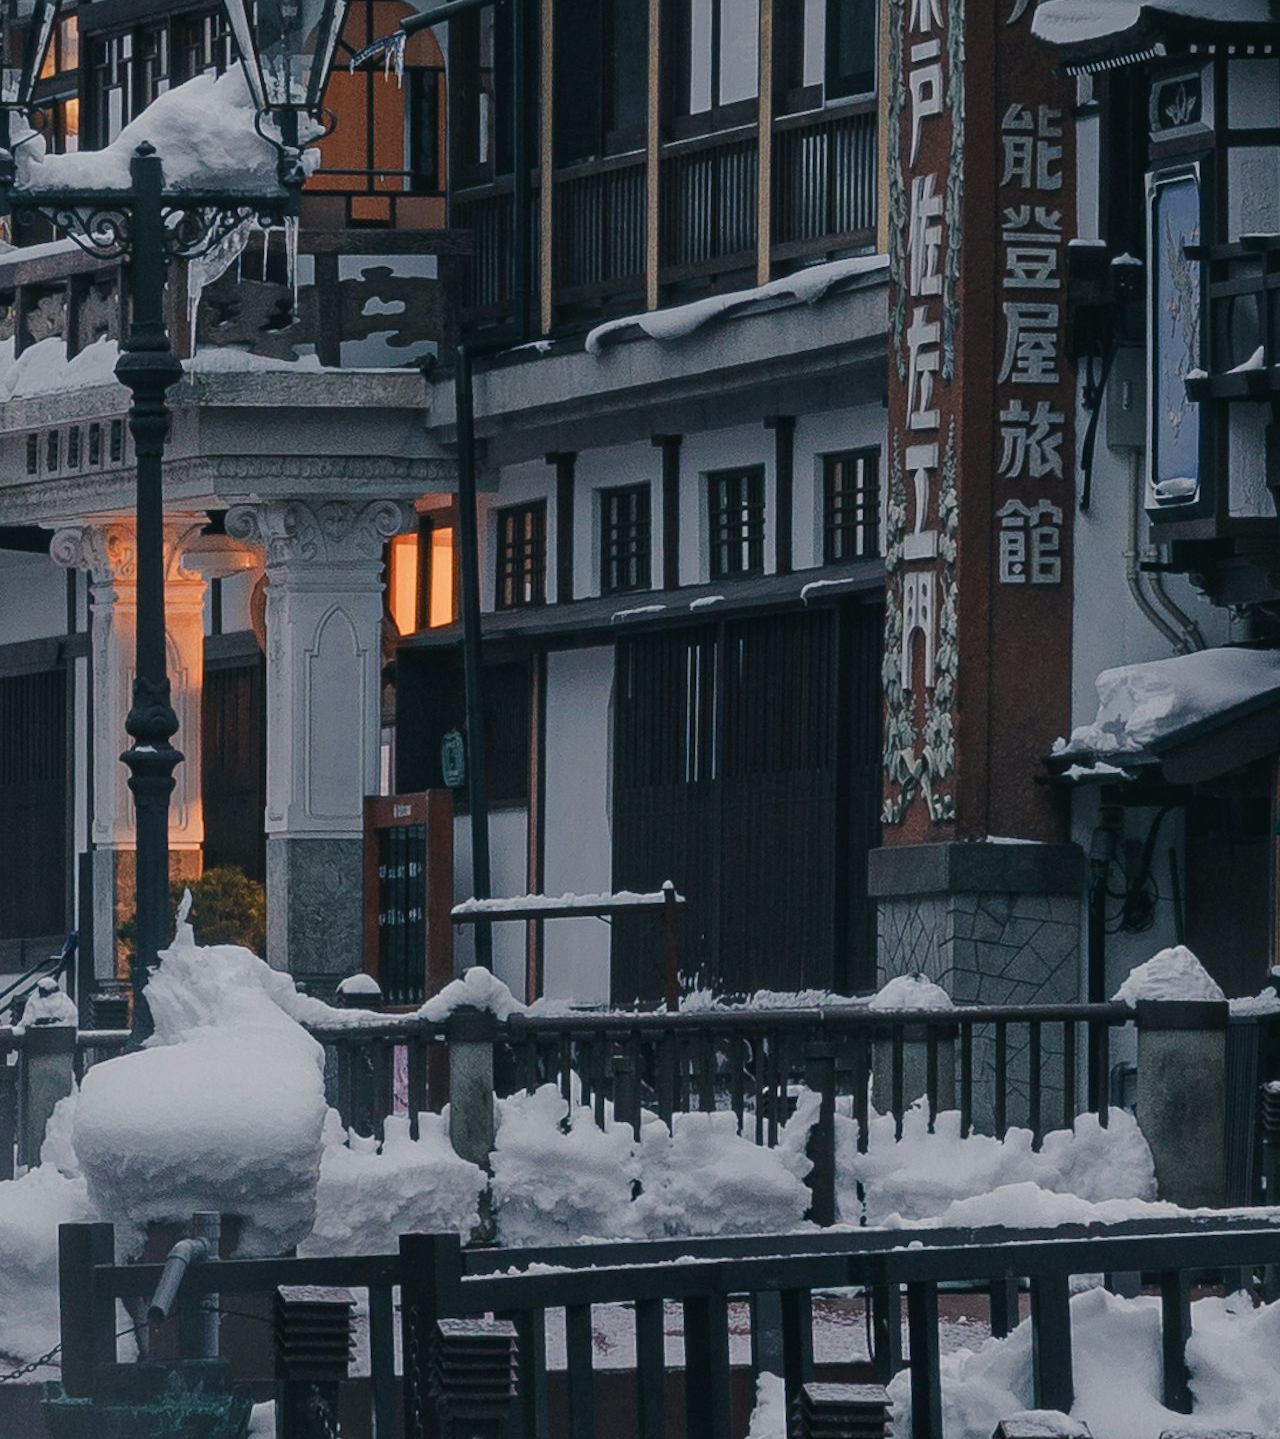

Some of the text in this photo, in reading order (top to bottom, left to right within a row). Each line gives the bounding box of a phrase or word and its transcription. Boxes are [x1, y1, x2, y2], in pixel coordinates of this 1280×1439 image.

[996, 103, 1065, 585] 能登屋旅館
